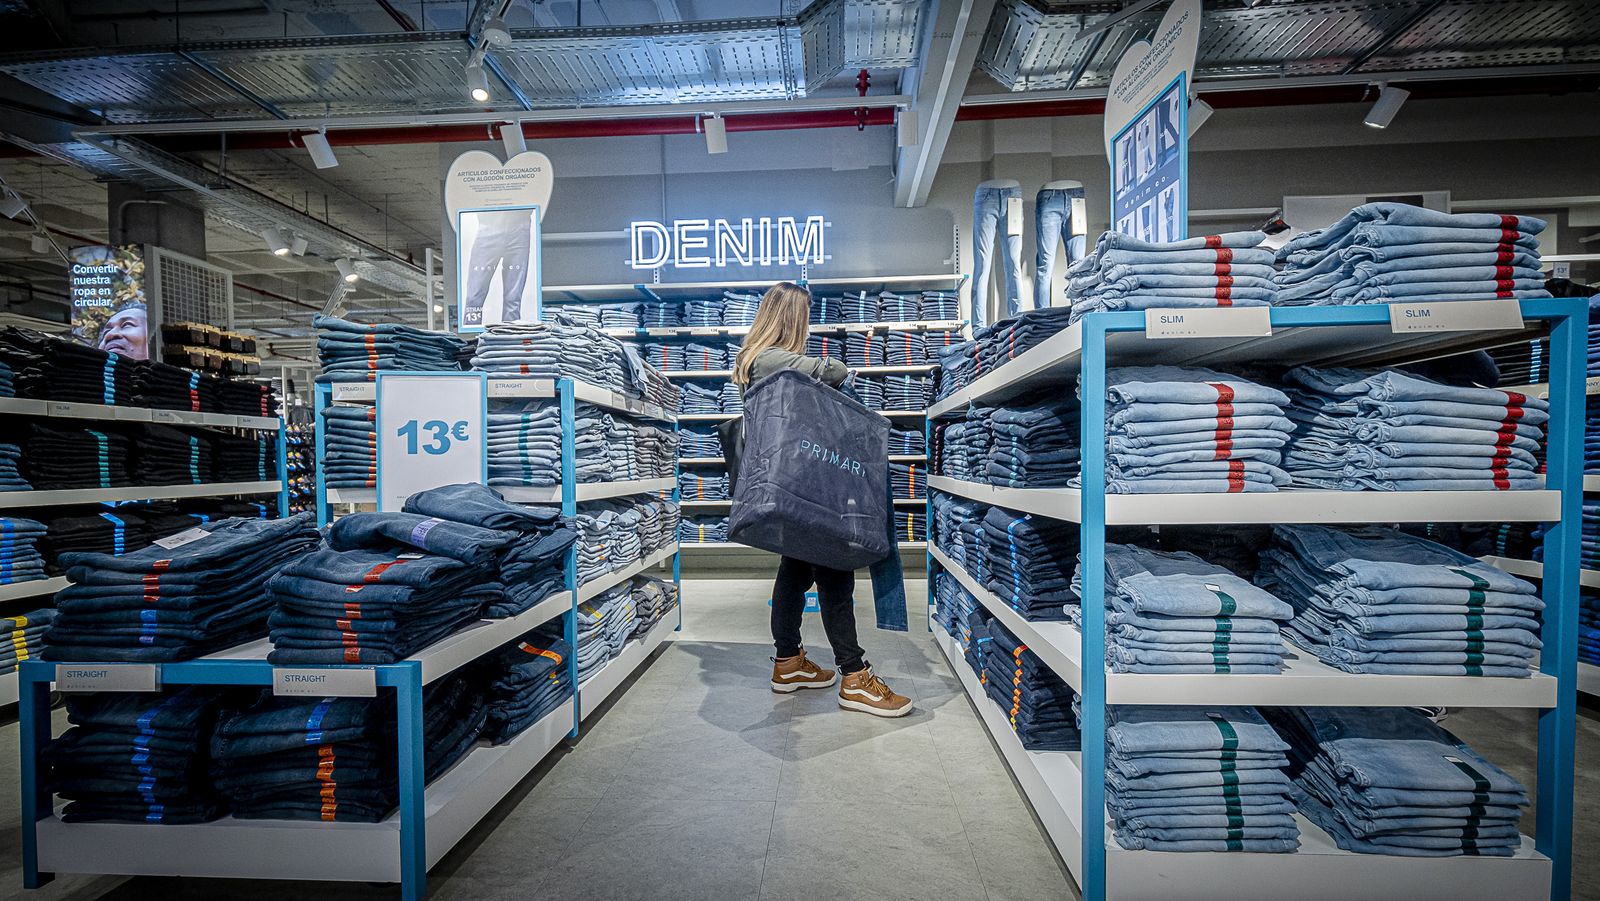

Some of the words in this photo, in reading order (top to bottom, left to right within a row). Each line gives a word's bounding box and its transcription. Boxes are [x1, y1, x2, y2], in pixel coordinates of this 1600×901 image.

[489, 167, 541, 176] CONFECCIONADOS
[1124, 186, 1151, 209] denim
[631, 215, 824, 269] DENIM
[73, 264, 118, 274] Convertir
[73, 276, 111, 285] nuestra
[74, 288, 96, 297] ropa
[74, 297, 113, 307] circular,
[1405, 309, 1431, 318] SLIM
[1160, 315, 1184, 323] SLIM
[397, 420, 469, 455] 13€
[67, 670, 108, 678] STRAIGHT
